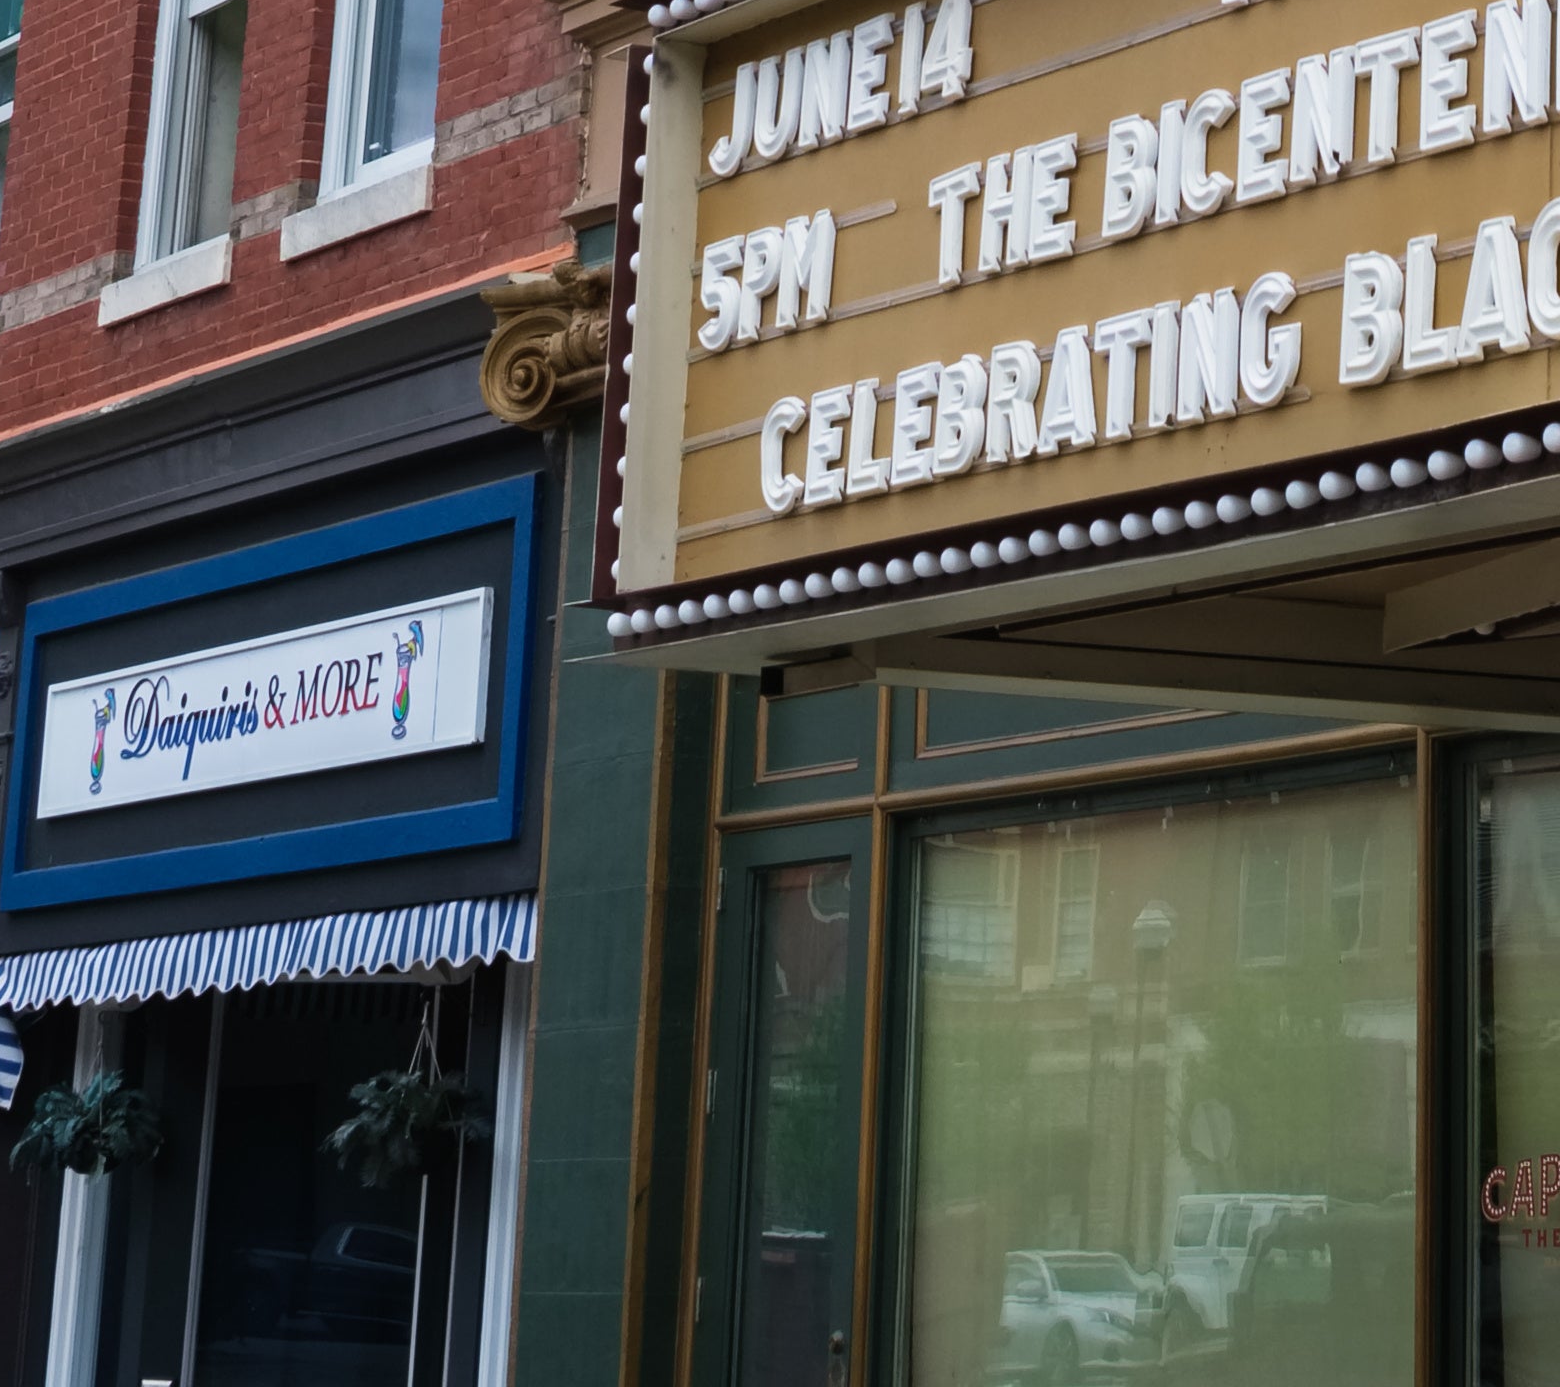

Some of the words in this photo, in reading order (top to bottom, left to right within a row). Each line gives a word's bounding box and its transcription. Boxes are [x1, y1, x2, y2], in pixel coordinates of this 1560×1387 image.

[698, 208, 838, 353] 5PM
[928, 133, 1078, 287] THE
[759, 272, 1304, 516] CELEBRATING
[264, 675, 286, 730] &
[290, 652, 384, 725] MORE
